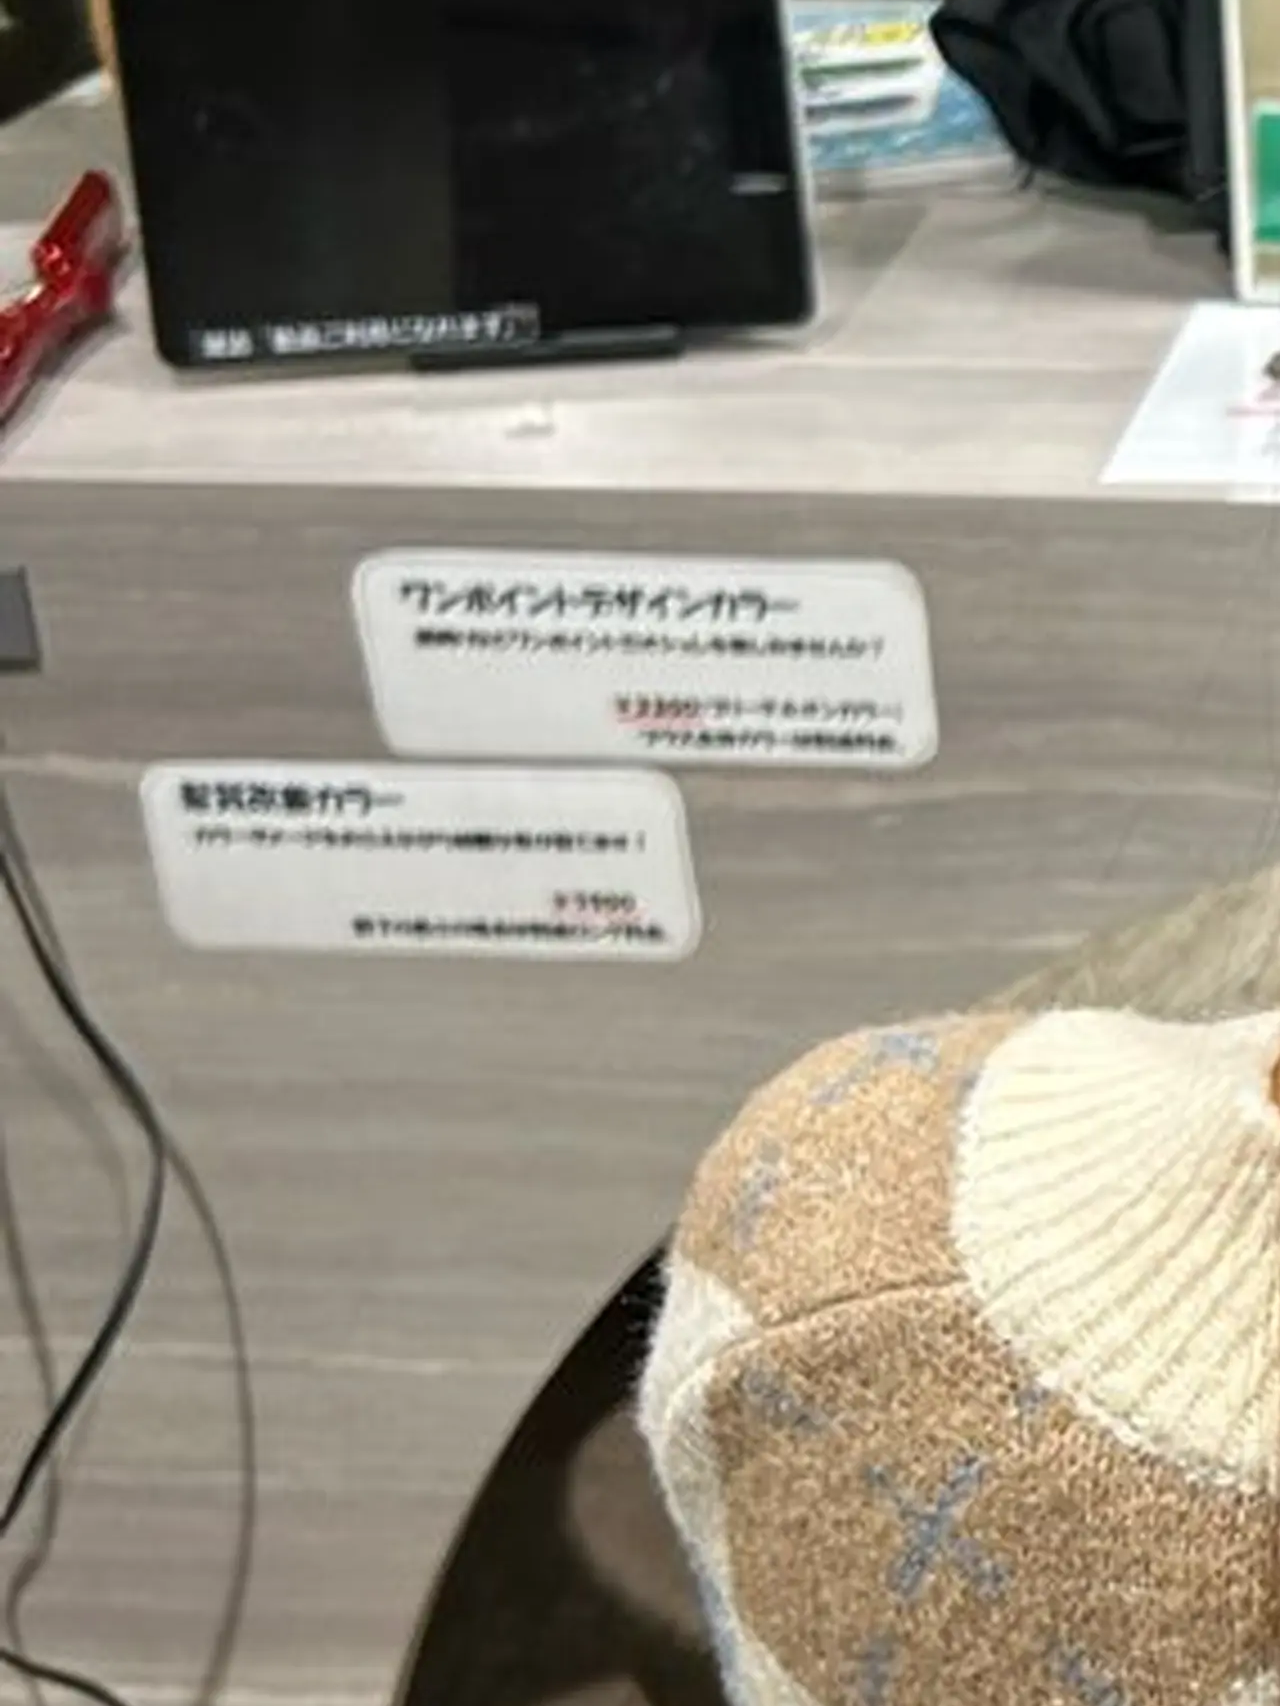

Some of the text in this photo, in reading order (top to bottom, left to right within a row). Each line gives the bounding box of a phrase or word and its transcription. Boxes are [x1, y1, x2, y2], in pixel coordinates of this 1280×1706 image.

[399, 582, 801, 622] ワンポイントデザインカラー
